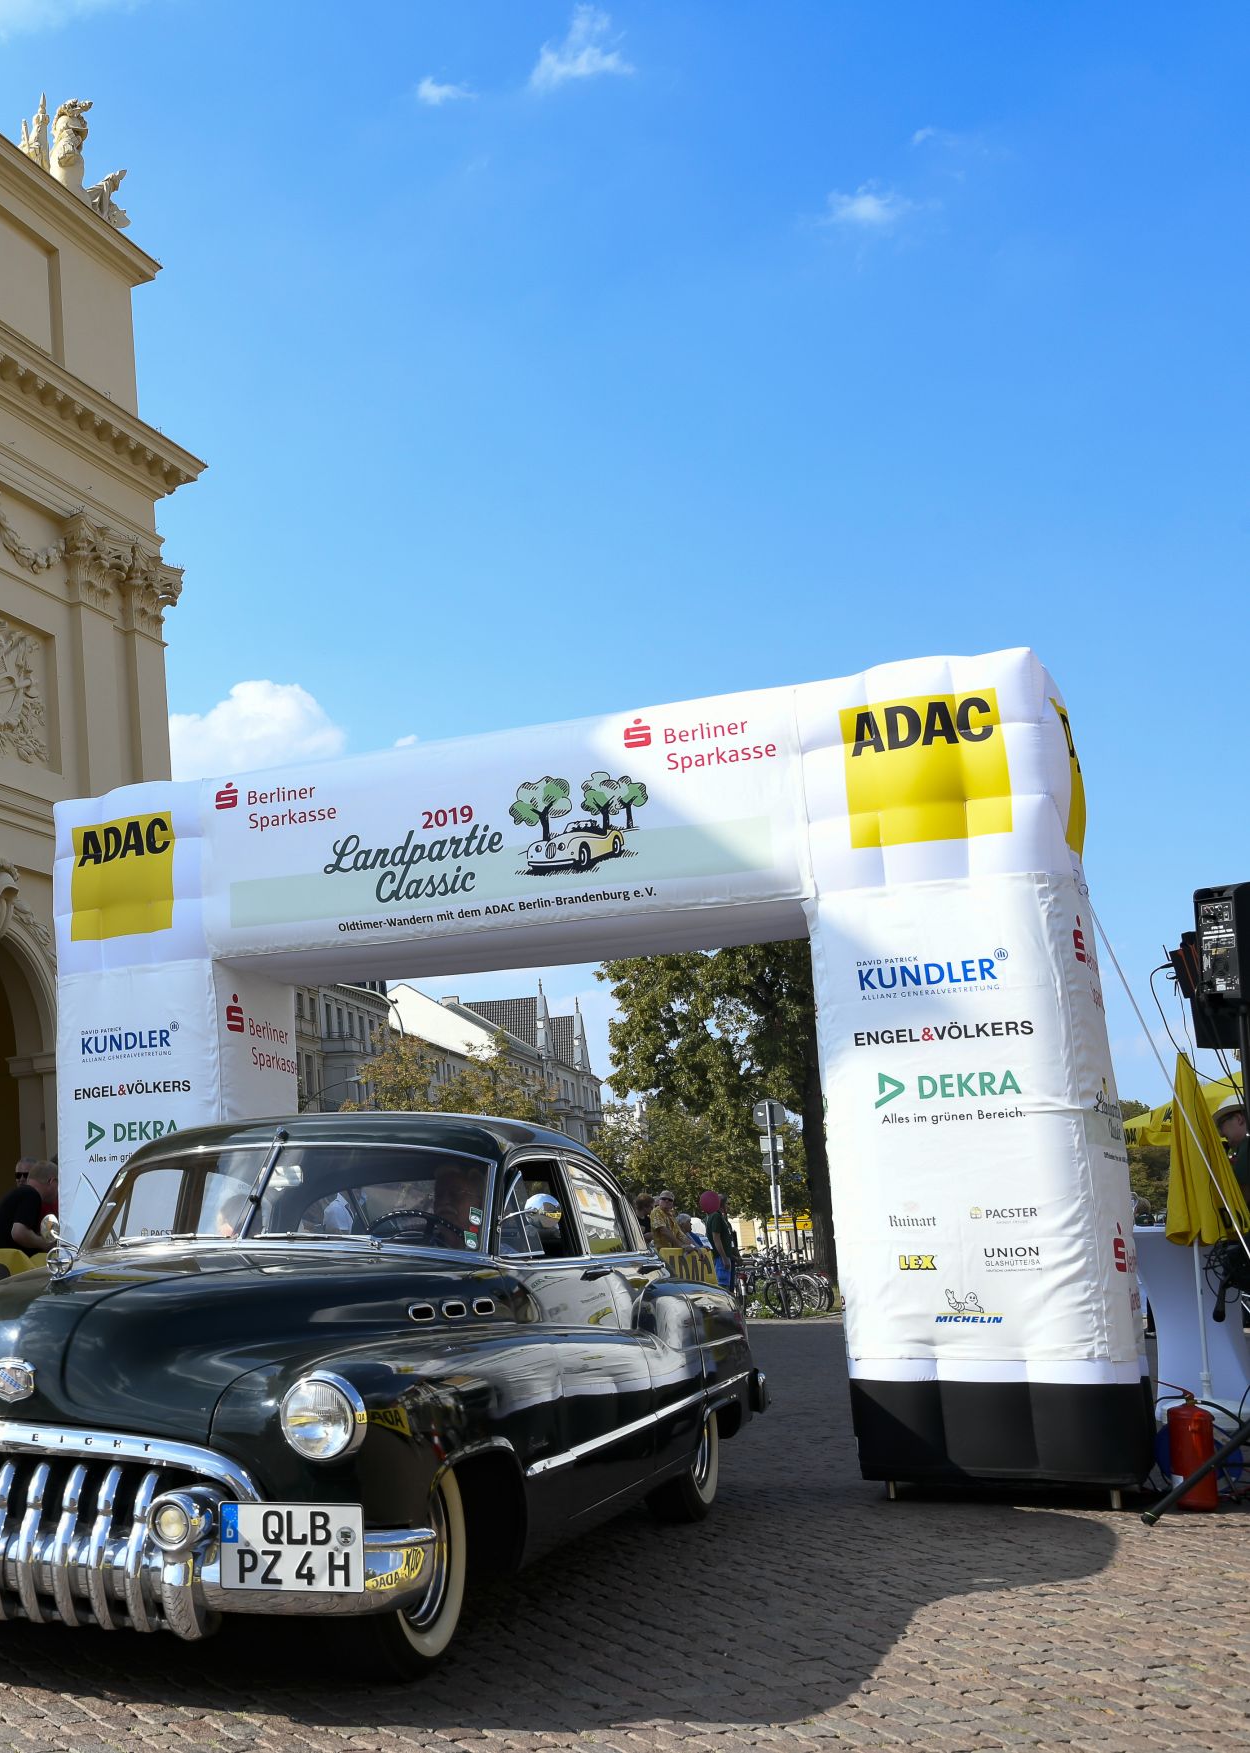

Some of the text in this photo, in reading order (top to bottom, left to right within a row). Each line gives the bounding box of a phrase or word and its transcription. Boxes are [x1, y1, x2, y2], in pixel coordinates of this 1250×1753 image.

[664, 720, 748, 744] Berliner
[851, 697, 994, 757] ADAC
[666, 743, 777, 773] Sparkasse
[247, 786, 316, 805] Berliner
[249, 807, 337, 832] Sparkasse
[421, 805, 473, 829] 2019
[78, 818, 171, 868] ADAC
[323, 824, 504, 875] Landpartie
[375, 863, 476, 903] Classic
[338, 914, 434, 932] Oldtimer-Wandern
[436, 910, 454, 922] mit
[457, 908, 481, 919] dem
[484, 902, 515, 916] ADAC
[518, 890, 630, 911] Berlin-Brandenburg
[856, 955, 918, 967] DAVID PATRICK
[857, 958, 998, 991] KUNDLER
[861, 984, 1000, 1001] ALLIANZ GENERALVERTRETUNG
[81, 1029, 171, 1055] KUNDLER
[100, 1026, 122, 1034] PATRICK
[248, 1017, 288, 1045] Berliner
[853, 1020, 1034, 1047] ENGEL&VÖLKERS
[74, 1079, 191, 1101] ENGEL&VÖLKERS
[917, 1069, 1022, 1099] DEKRA
[881, 1107, 1026, 1125] Alles im grünen Bereich.
[88, 1153, 107, 1163] Alles
[109, 1153, 118, 1162] im
[888, 1215, 937, 1227] Ruinart
[985, 1207, 1038, 1219] PACSTER
[898, 1254, 937, 1271] LEX
[983, 1246, 1040, 1258] UNION
[934, 1315, 1003, 1324] MICHELIN
[31, 1433, 151, 1452] EIGHT
[225, 1528, 234, 1539] D
[262, 1510, 332, 1545] QLB
[237, 1549, 350, 1587] PZ 4 H
